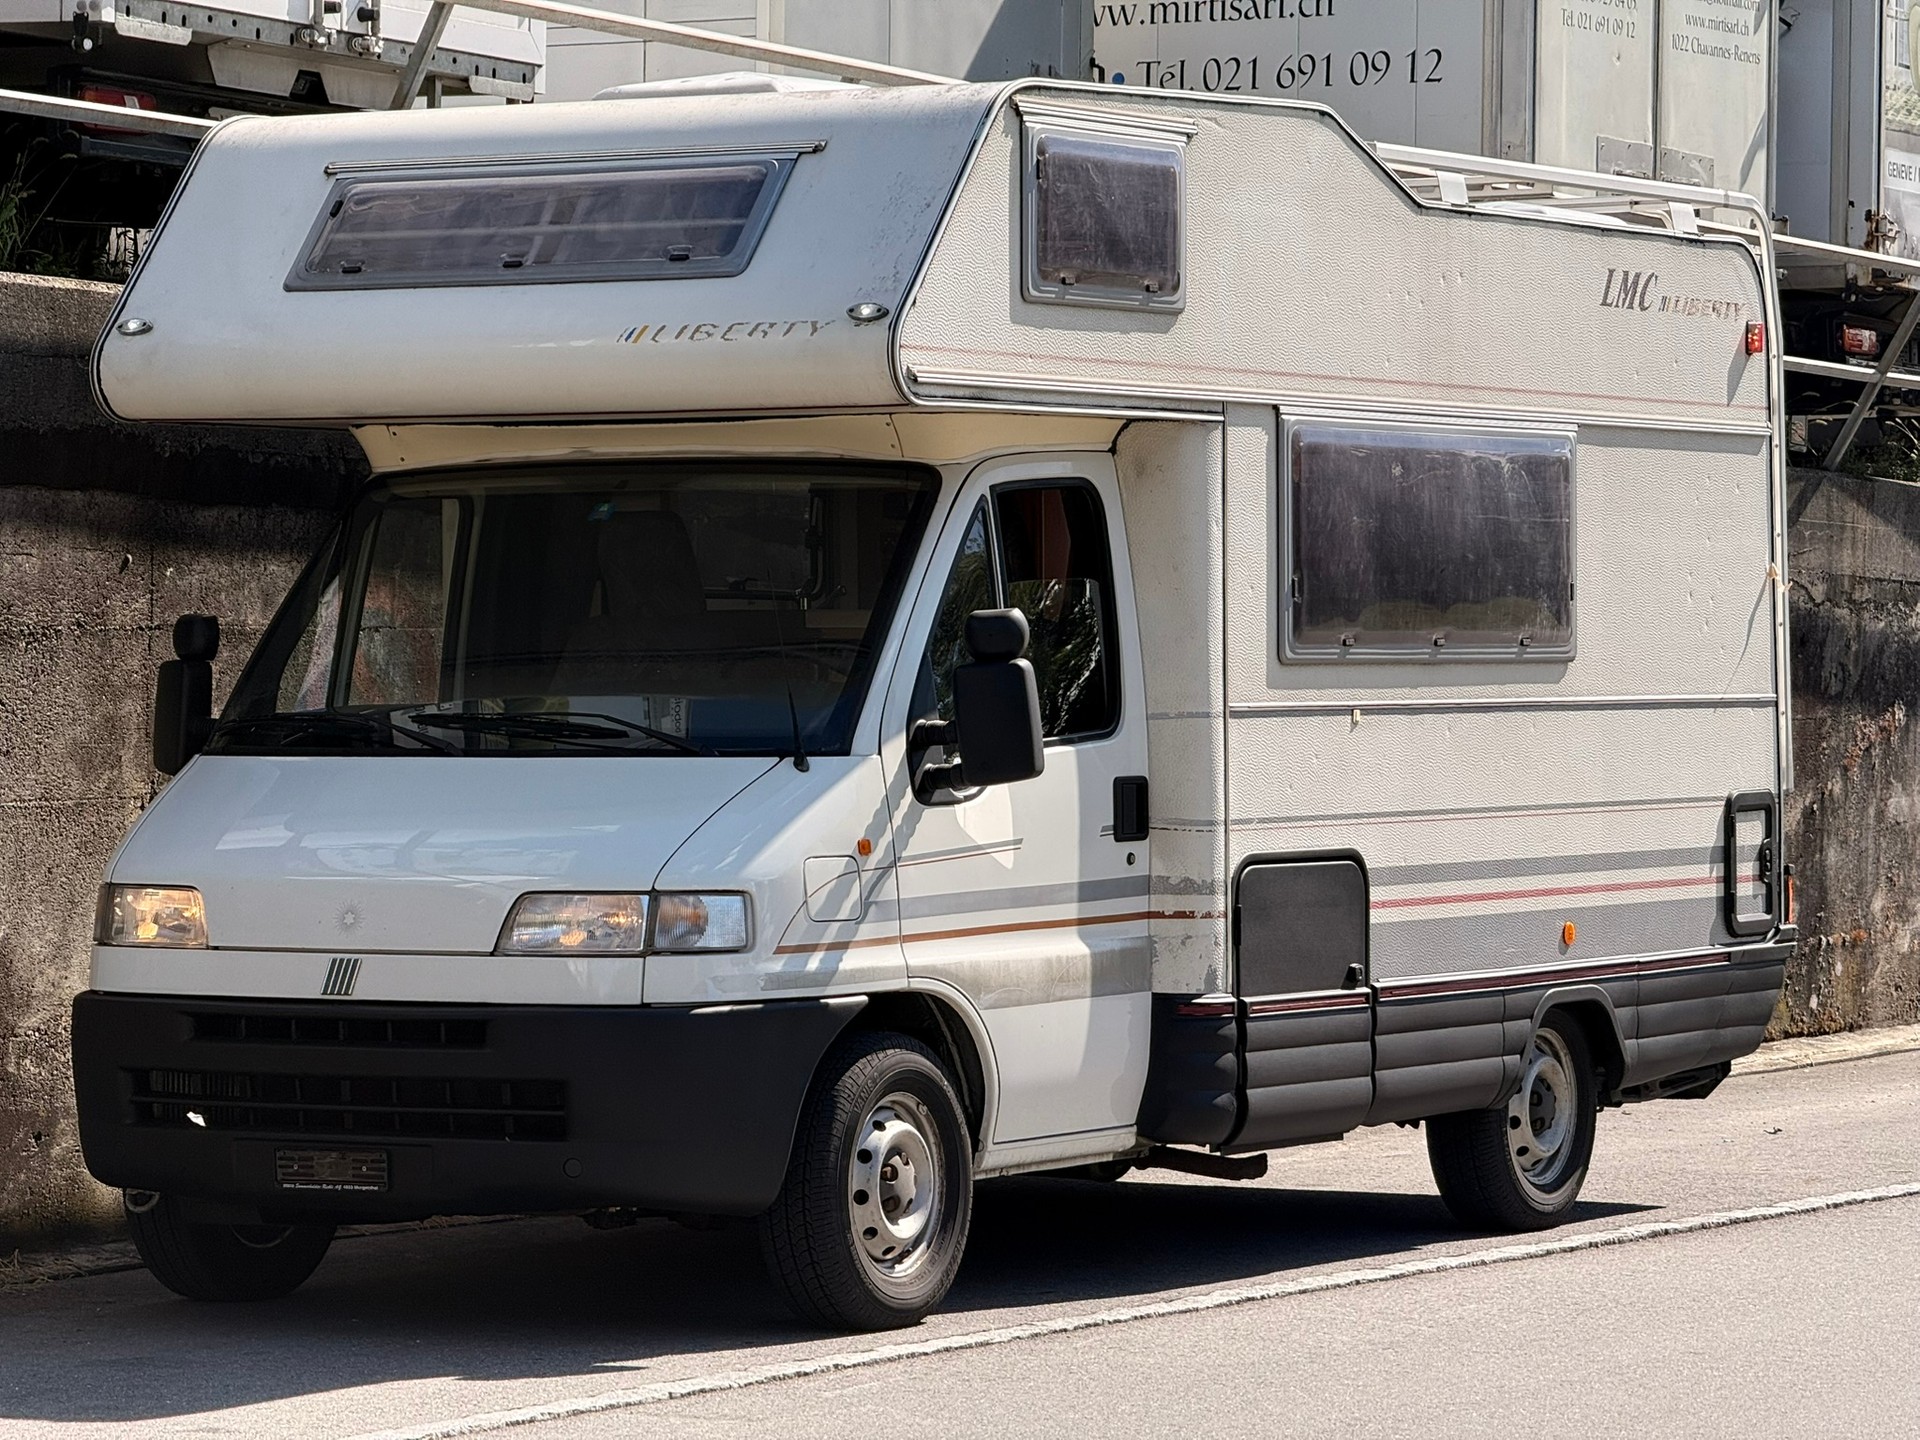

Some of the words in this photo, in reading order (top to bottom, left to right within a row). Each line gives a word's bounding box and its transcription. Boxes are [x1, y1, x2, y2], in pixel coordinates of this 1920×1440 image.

[1577, 11, 1591, 31] 021
[1594, 15, 1609, 34] 691
[1612, 18, 1623, 36] 09
[1626, 21, 1636, 38] 12
[1685, 14, 1750, 37] www.mirtisarl.ch
[1671, 34, 1689, 52] 1022
[1690, 36, 1761, 65] Chavannes-Renens
[1136, 59, 1194, 91] Tél.
[1202, 55, 1260, 92] 021
[1275, 52, 1334, 89] 691
[1349, 50, 1391, 87] 09
[1405, 48, 1443, 84] 12
[1888, 161, 1912, 181] GENEVE
[1600, 268, 1658, 312] LMC
